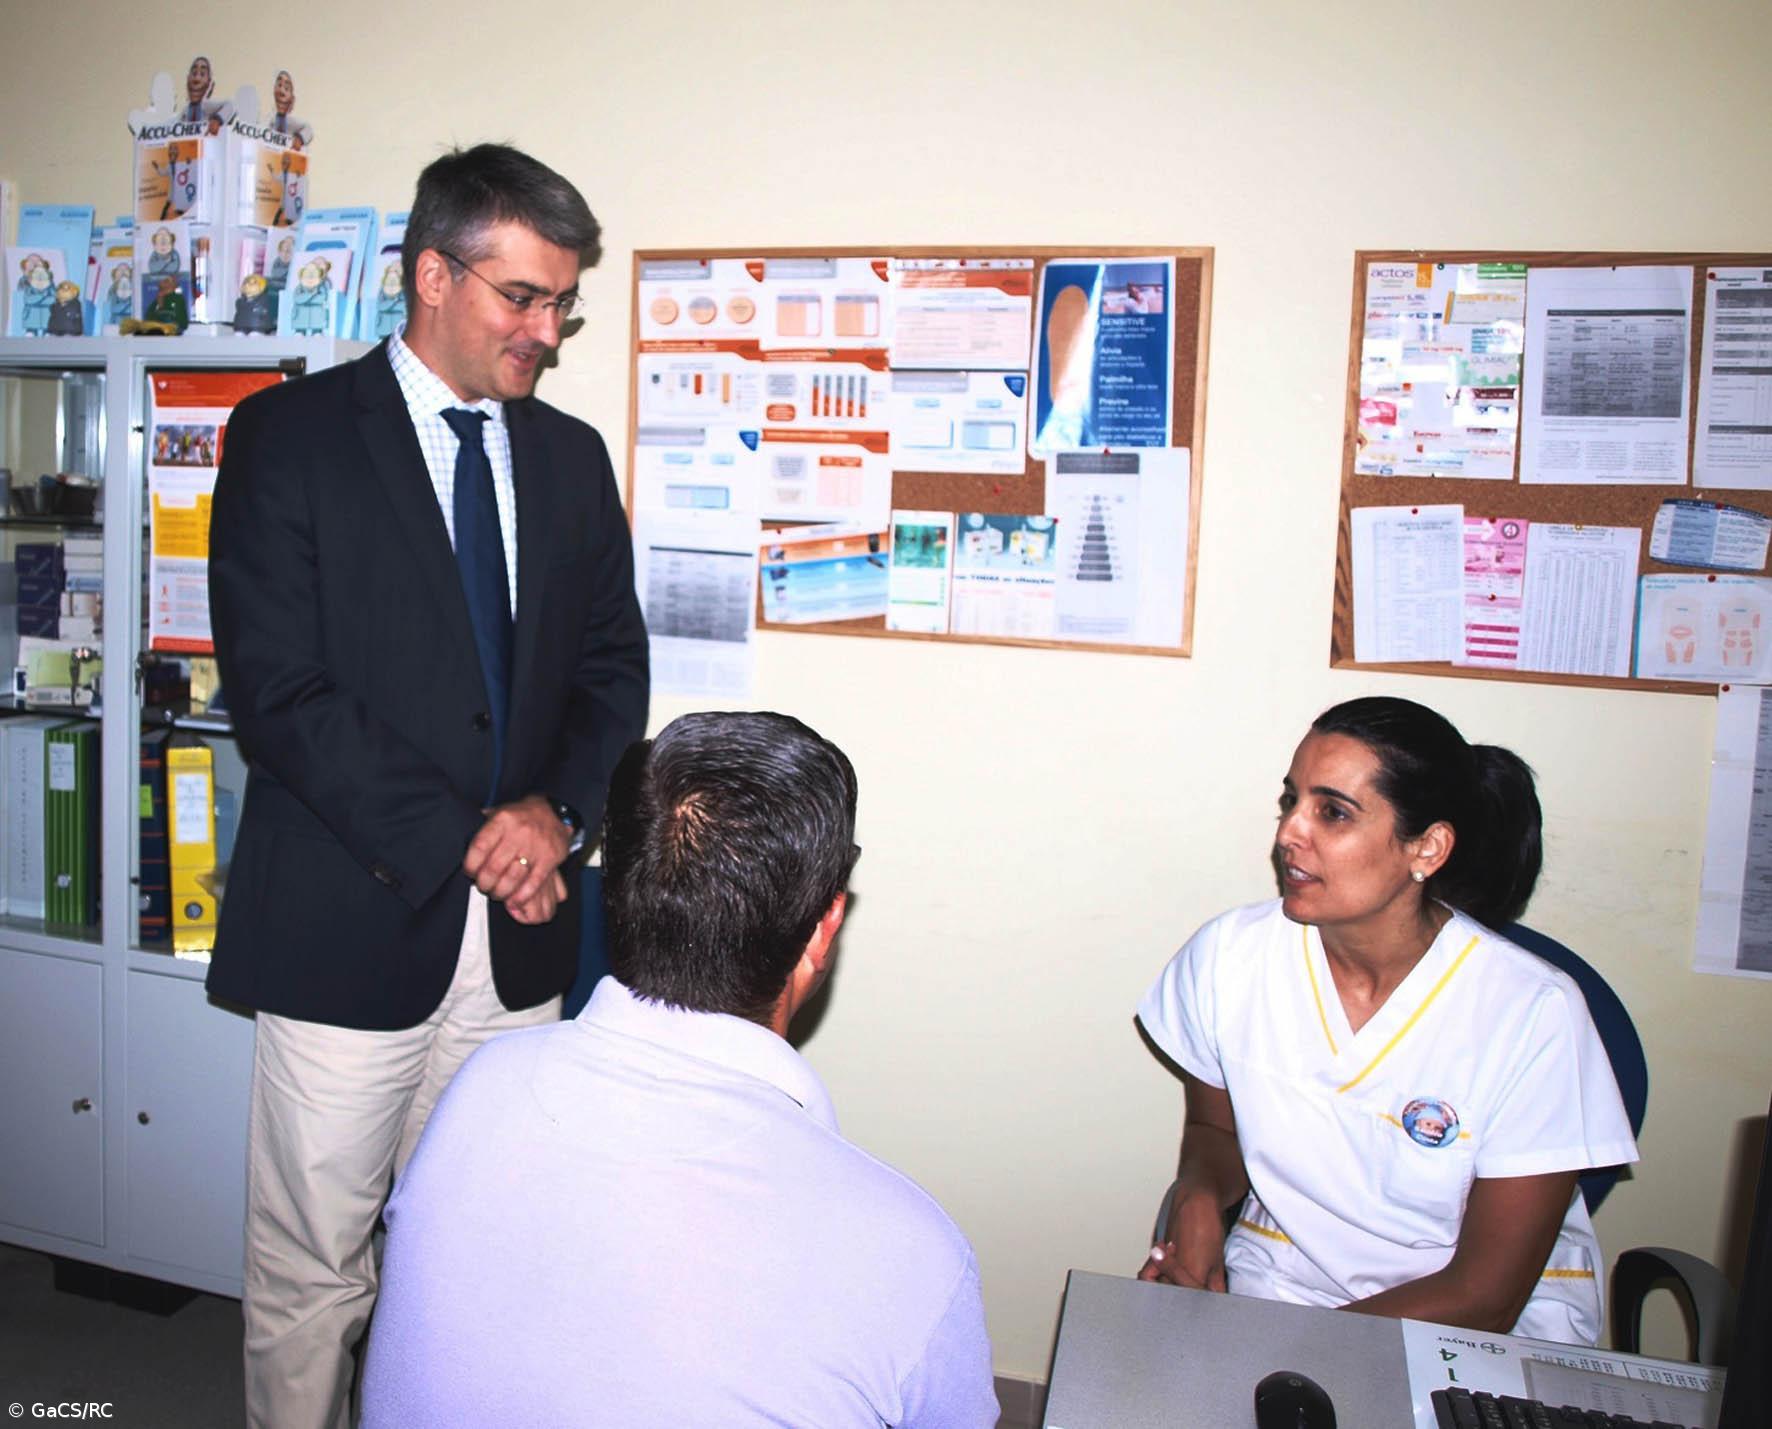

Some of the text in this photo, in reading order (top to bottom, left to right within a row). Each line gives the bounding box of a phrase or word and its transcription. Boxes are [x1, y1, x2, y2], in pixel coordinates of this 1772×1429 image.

[138, 122, 203, 141] ACCU-CHEK
[1371, 268, 1414, 278] actos
[1100, 318, 1146, 326] SENSITIVE
[1099, 376, 1134, 384] Palmilha
[1438, 1337, 1476, 1349] Bayer
